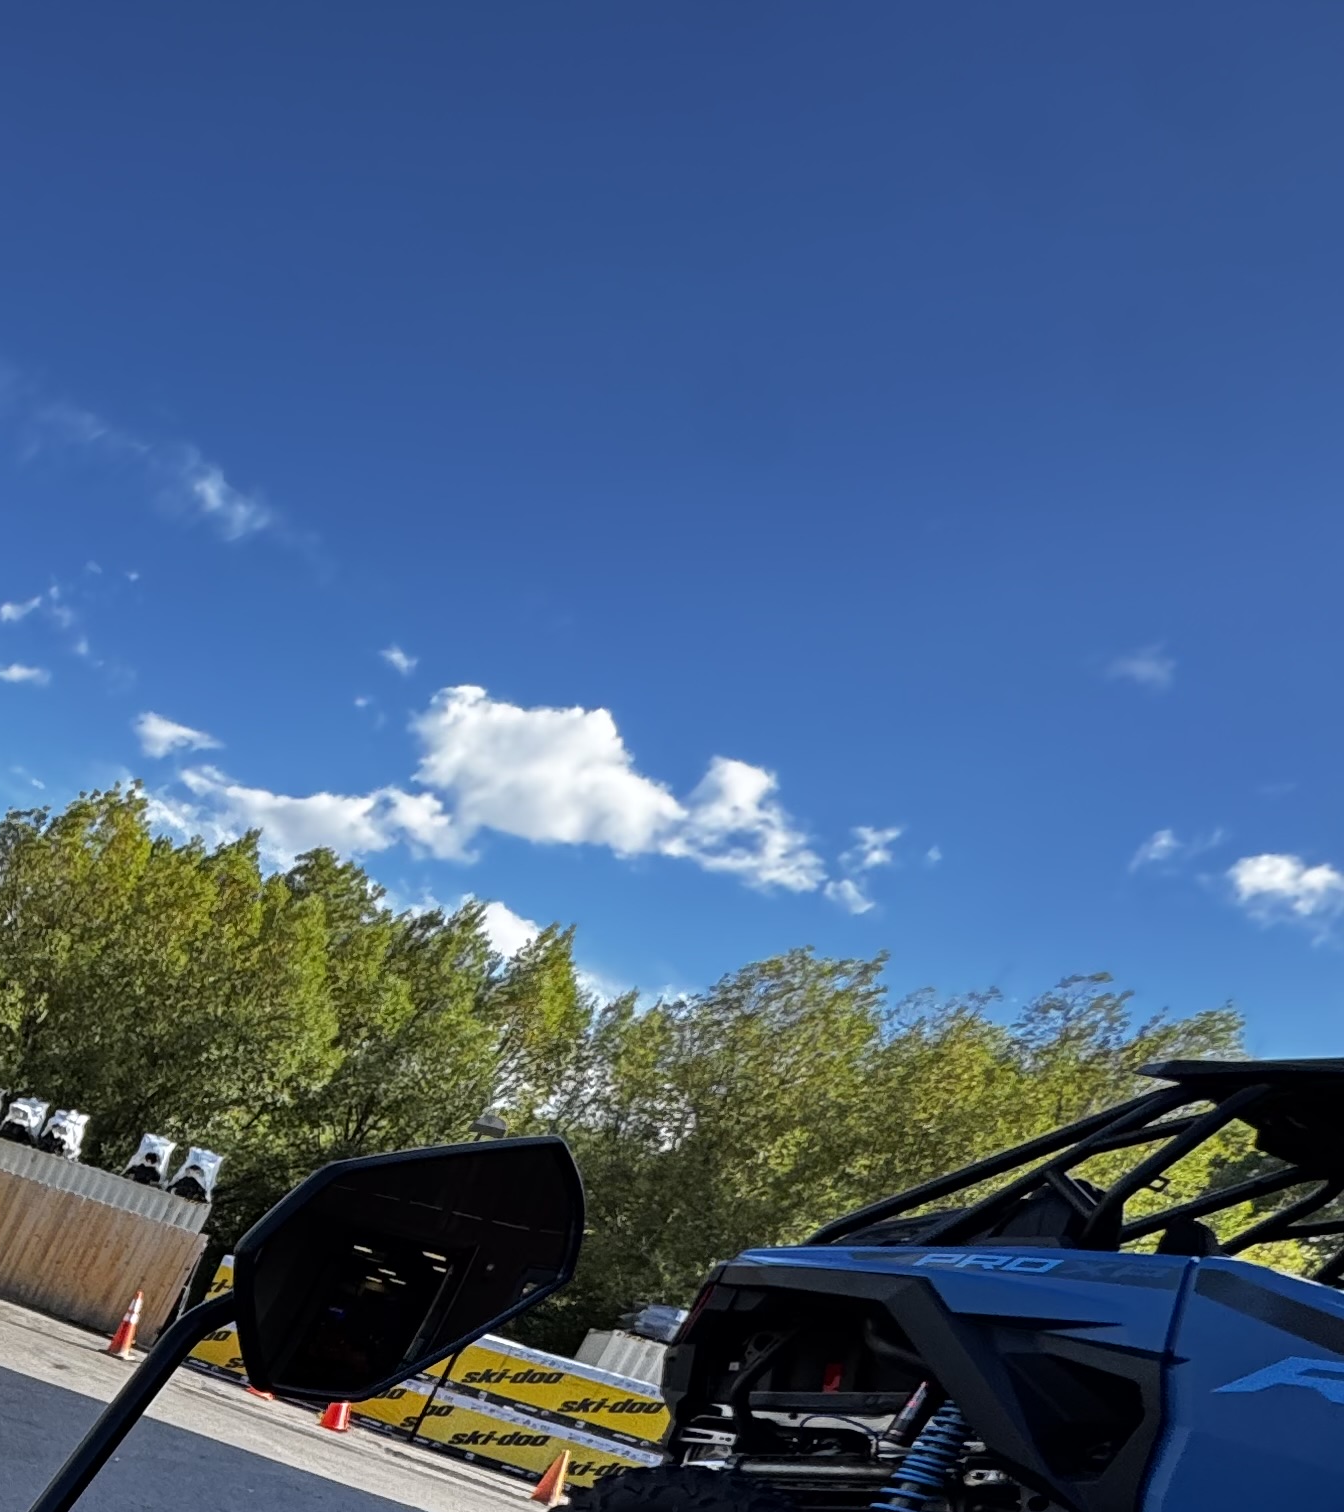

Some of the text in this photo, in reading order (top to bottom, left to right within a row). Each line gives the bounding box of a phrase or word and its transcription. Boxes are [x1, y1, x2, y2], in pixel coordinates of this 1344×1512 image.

[913, 1253, 1064, 1273] PRO
[462, 1368, 565, 1384] ski-doo
[556, 1397, 666, 1415] ski-doo
[447, 1430, 551, 1447] ski-doo
